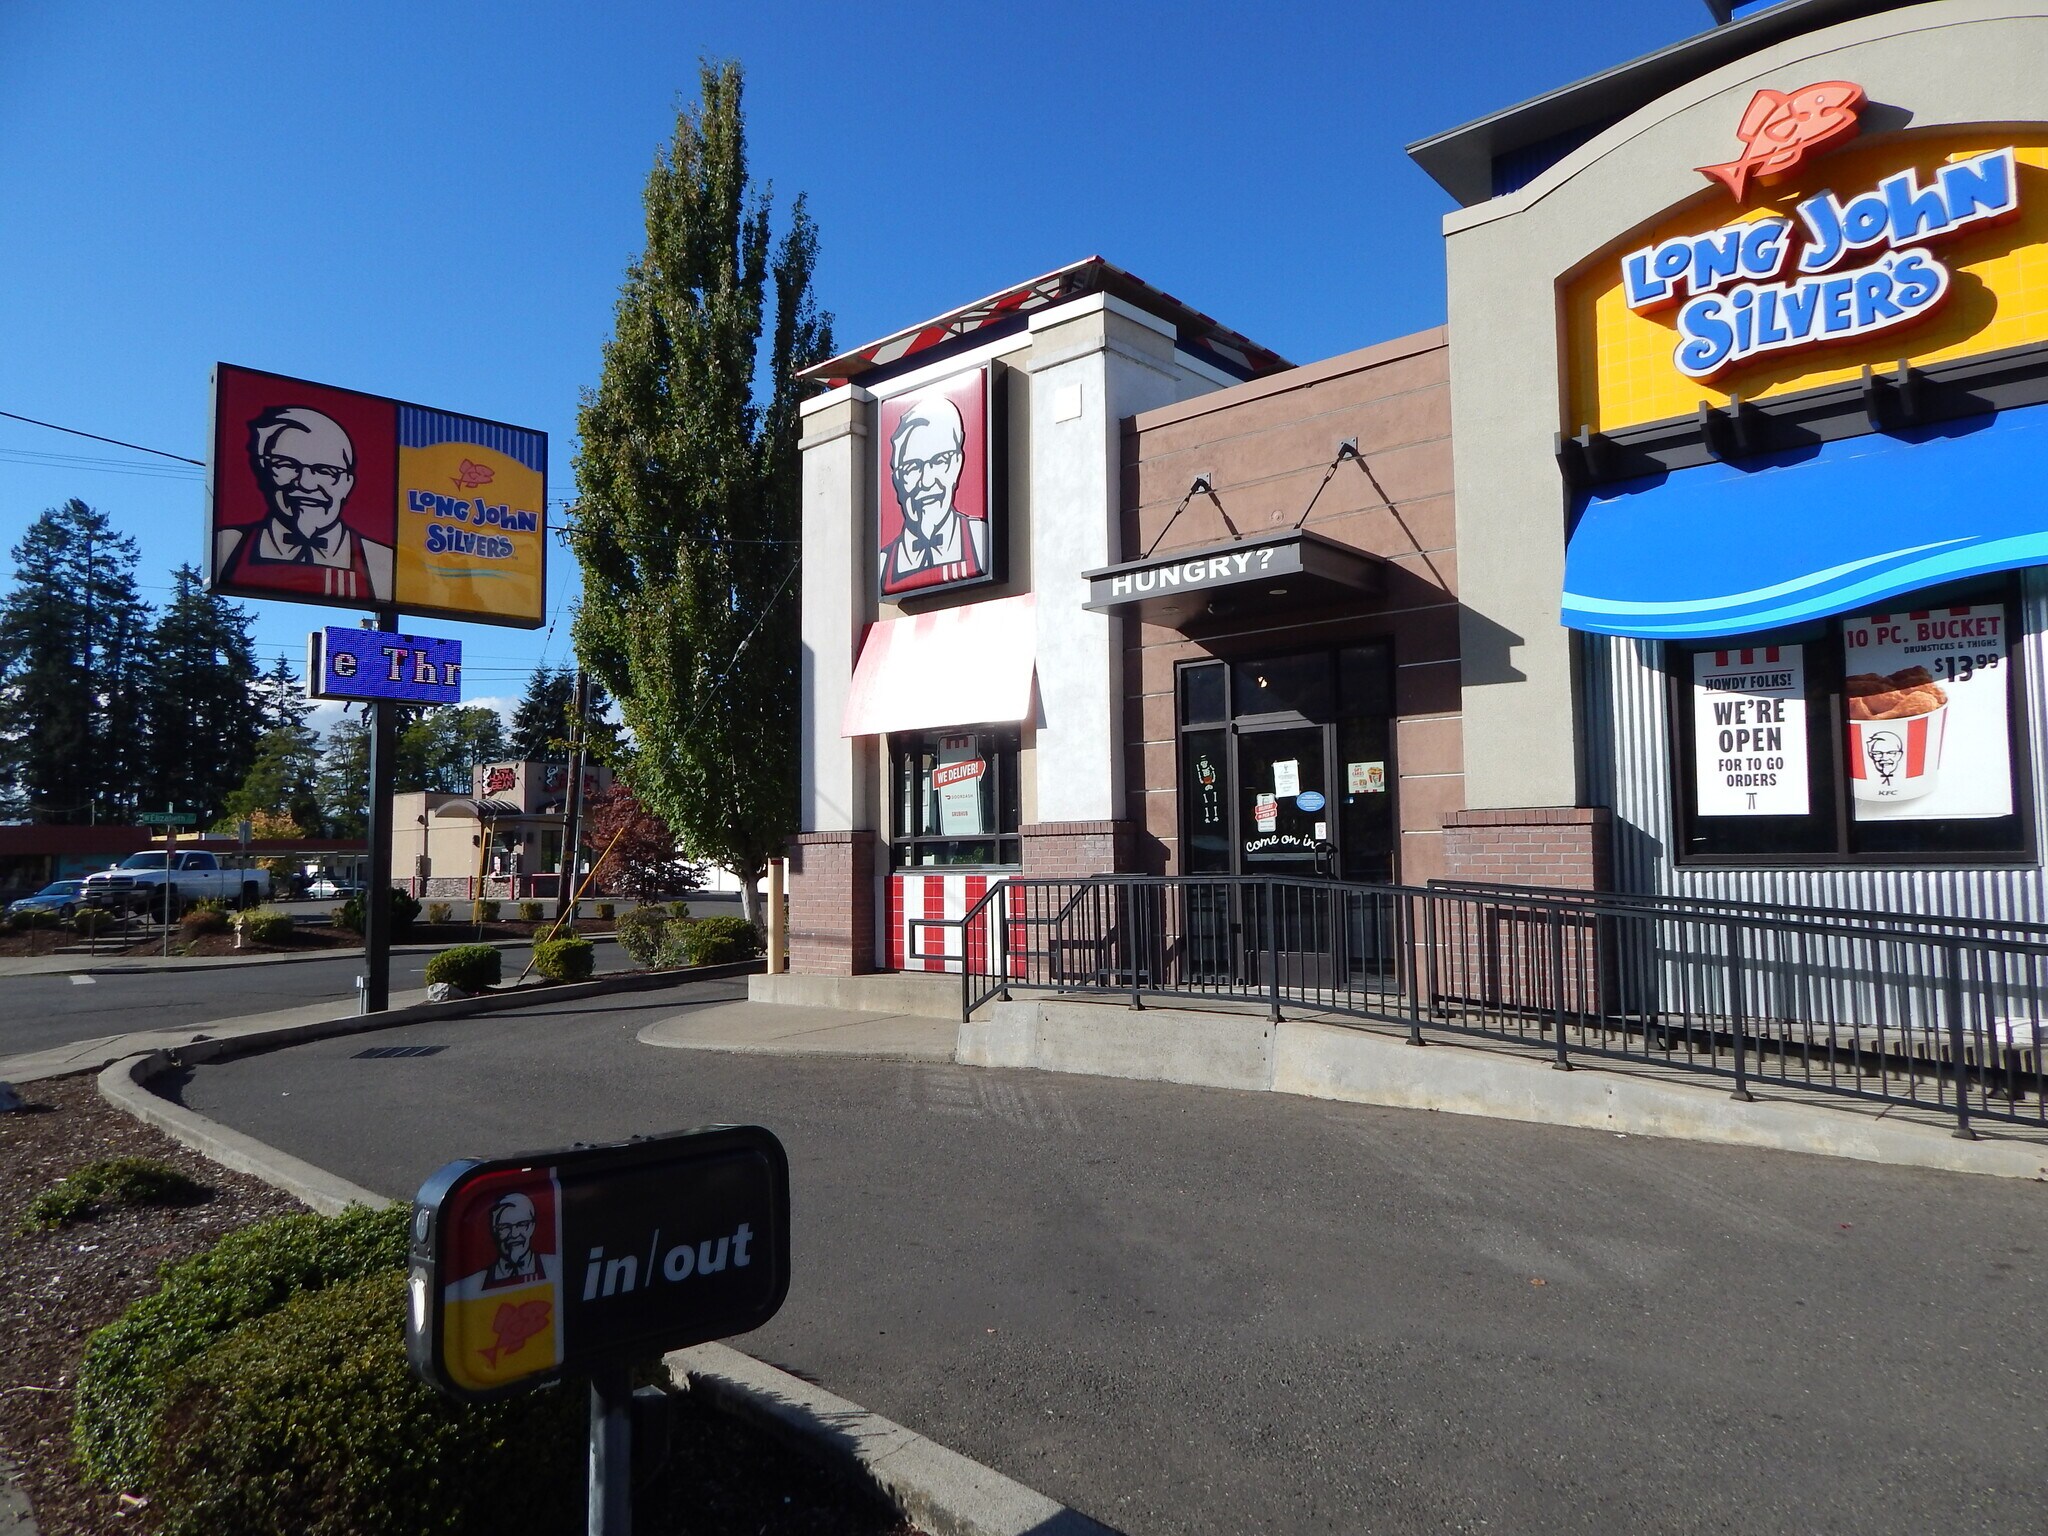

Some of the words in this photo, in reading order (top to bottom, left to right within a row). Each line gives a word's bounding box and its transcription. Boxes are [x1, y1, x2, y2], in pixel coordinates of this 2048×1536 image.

[1112, 546, 1274, 597] HUNGRY?
[1847, 629, 1868, 648] 10
[1877, 625, 1909, 645] PC.
[1917, 616, 2000, 642] BUCKET
[1904, 642, 1955, 654] DRUMSTICKS
[1967, 639, 1997, 649] THIGHS
[334, 653, 357, 676] e
[1705, 676, 1747, 691] HOWDY
[1750, 673, 1792, 688] FOLKS!
[1713, 698, 1785, 726] WE'RE
[1718, 727, 1782, 753] OPEN
[937, 770, 948, 784] WE
[948, 762, 979, 781] DELIVER!
[1718, 758, 1742, 772] FOR
[1746, 757, 1762, 771] TO
[1766, 756, 1784, 770] GO
[1726, 773, 1777, 787] ORDERS
[1246, 834, 1280, 852] come
[1281, 835, 1301, 846] on
[583, 1222, 754, 1302] in/out
